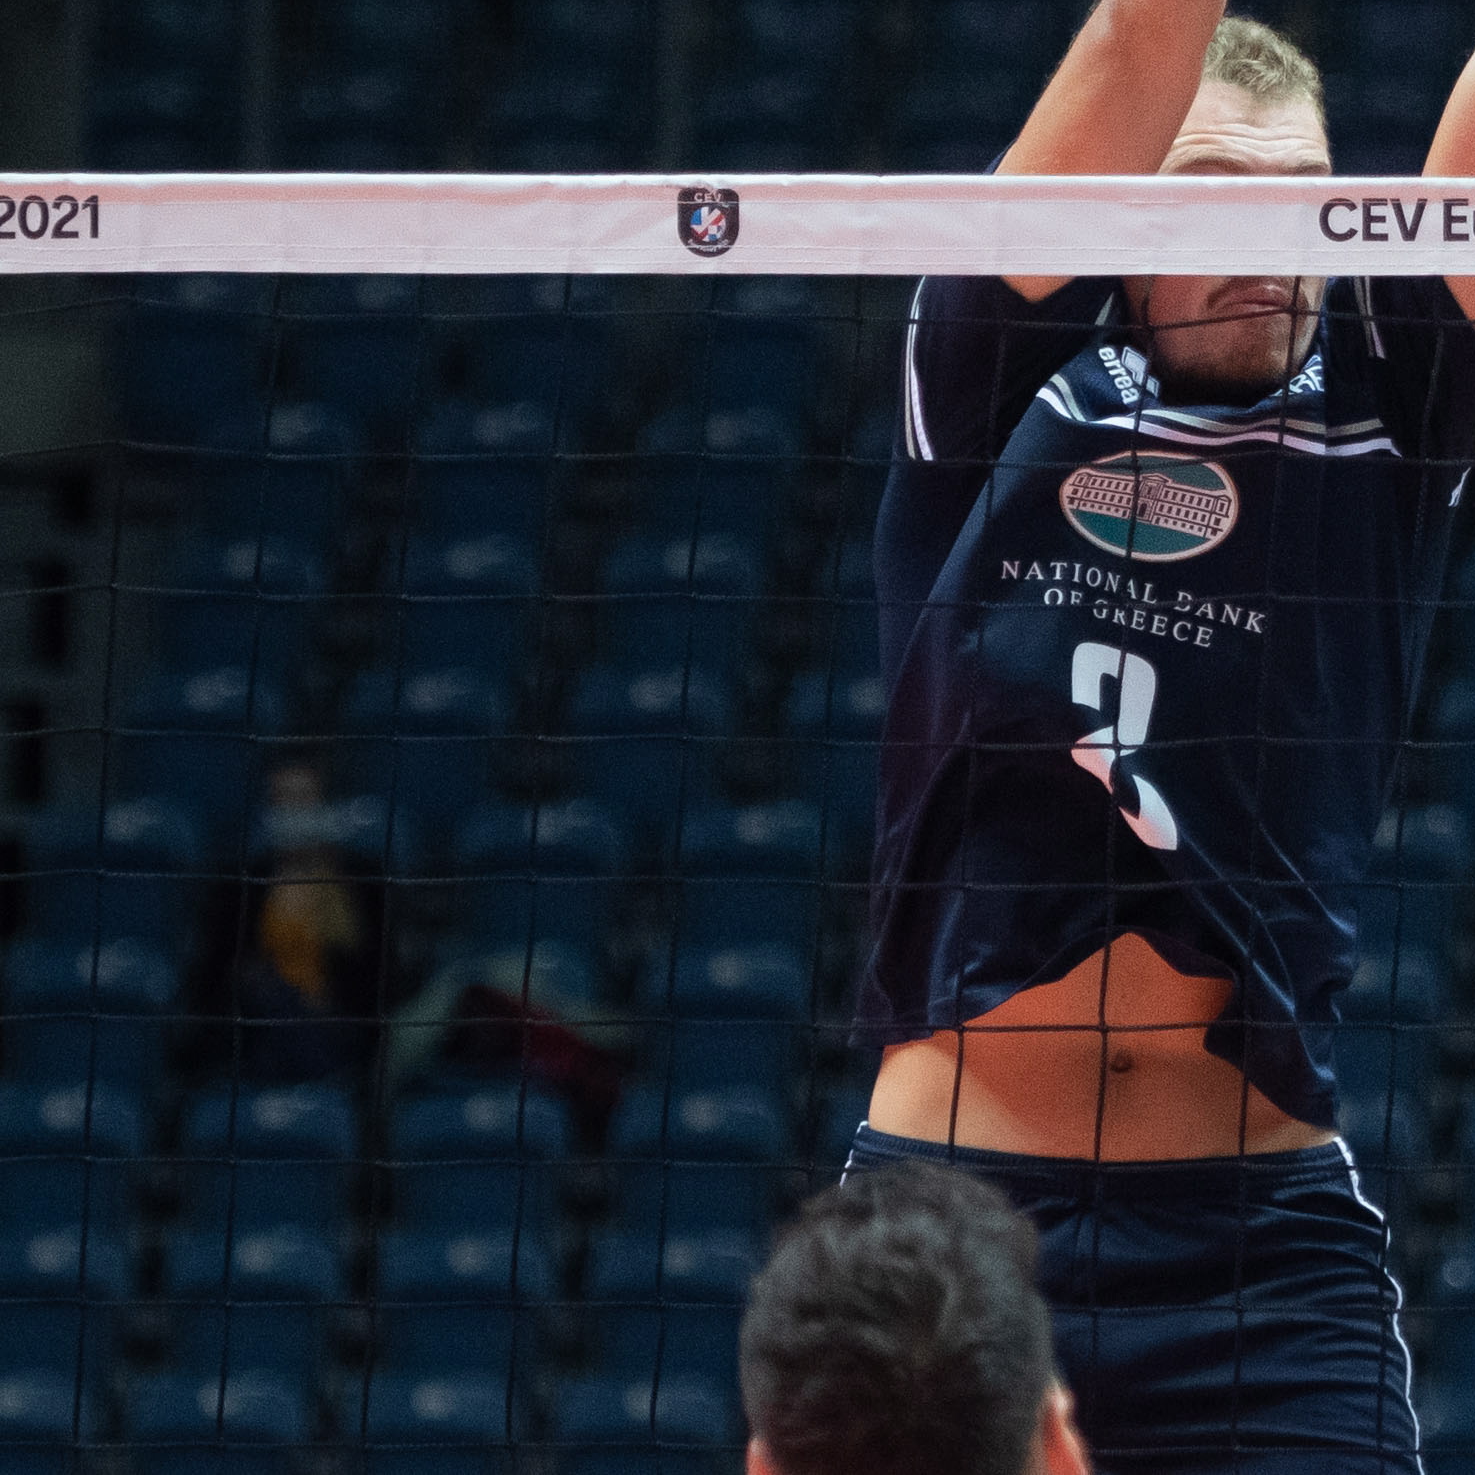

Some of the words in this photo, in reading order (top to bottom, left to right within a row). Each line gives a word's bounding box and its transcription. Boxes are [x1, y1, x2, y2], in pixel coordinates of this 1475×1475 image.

[1319, 198, 1428, 242] CEV
[1001, 560, 1158, 604] NATIONAL
[1173, 590, 1267, 634] BANK
[1093, 599, 1215, 649] GREECE
